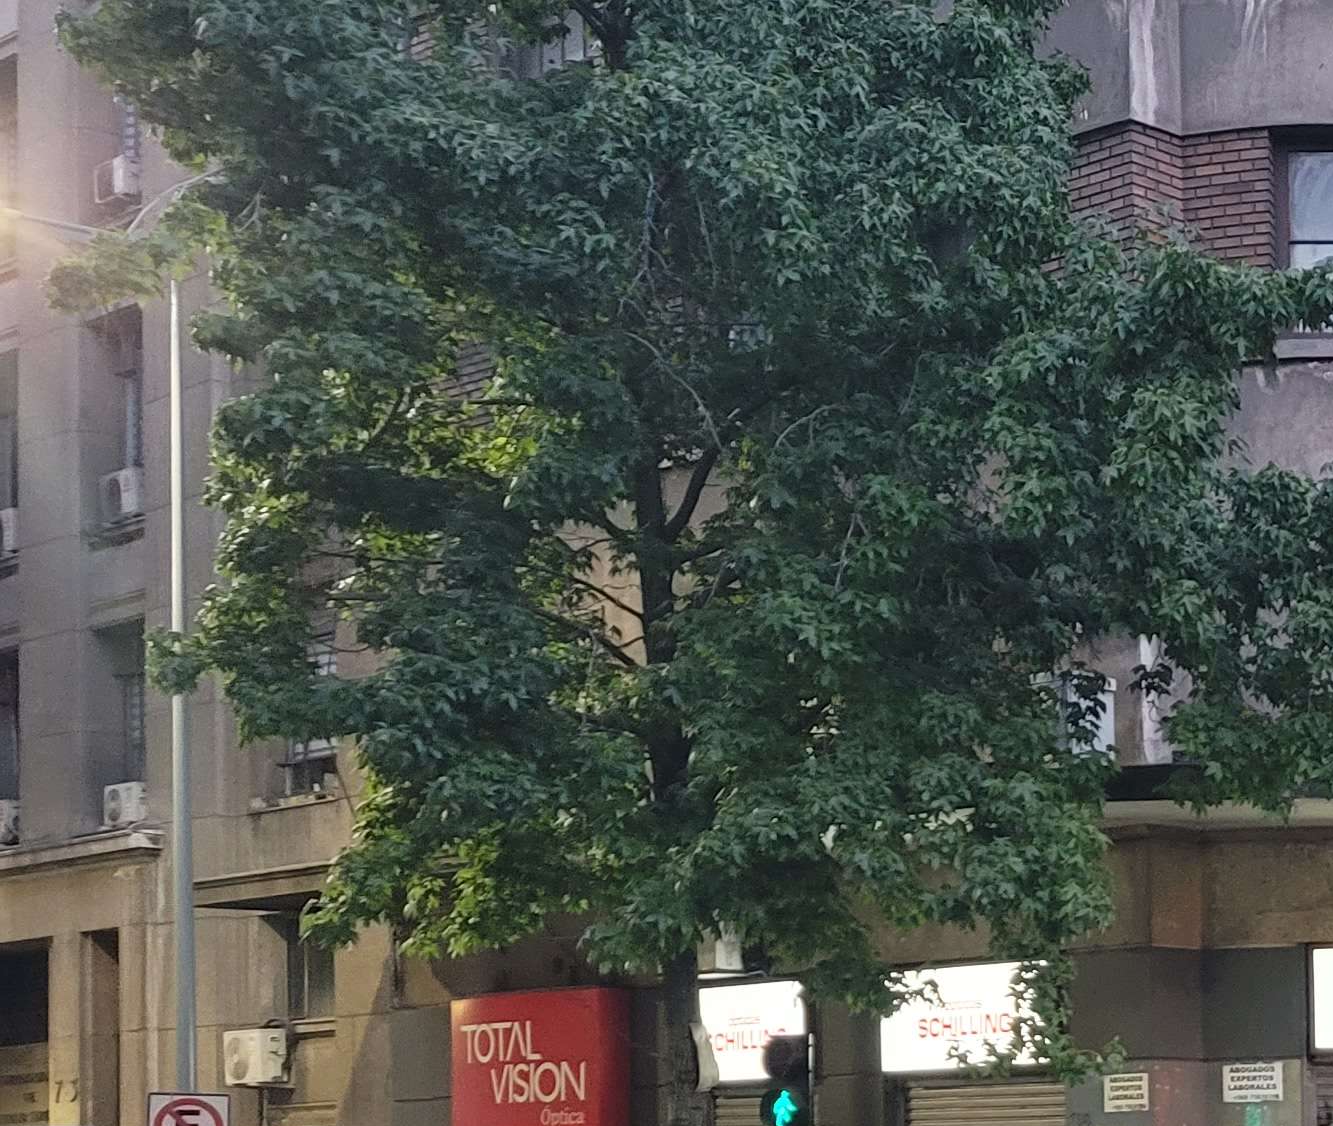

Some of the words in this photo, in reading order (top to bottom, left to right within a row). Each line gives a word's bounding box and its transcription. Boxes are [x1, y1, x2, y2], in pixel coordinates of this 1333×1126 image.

[918, 1012, 1011, 1038] SCHILLING
[460, 1020, 542, 1064] TOTAL
[706, 1027, 786, 1052] CHILLI
[1229, 1065, 1275, 1073] ABOGADOS
[1230, 1074, 1274, 1082] EXPERTOS
[490, 1060, 586, 1104] VISION
[1227, 1083, 1277, 1092] LABORALES
